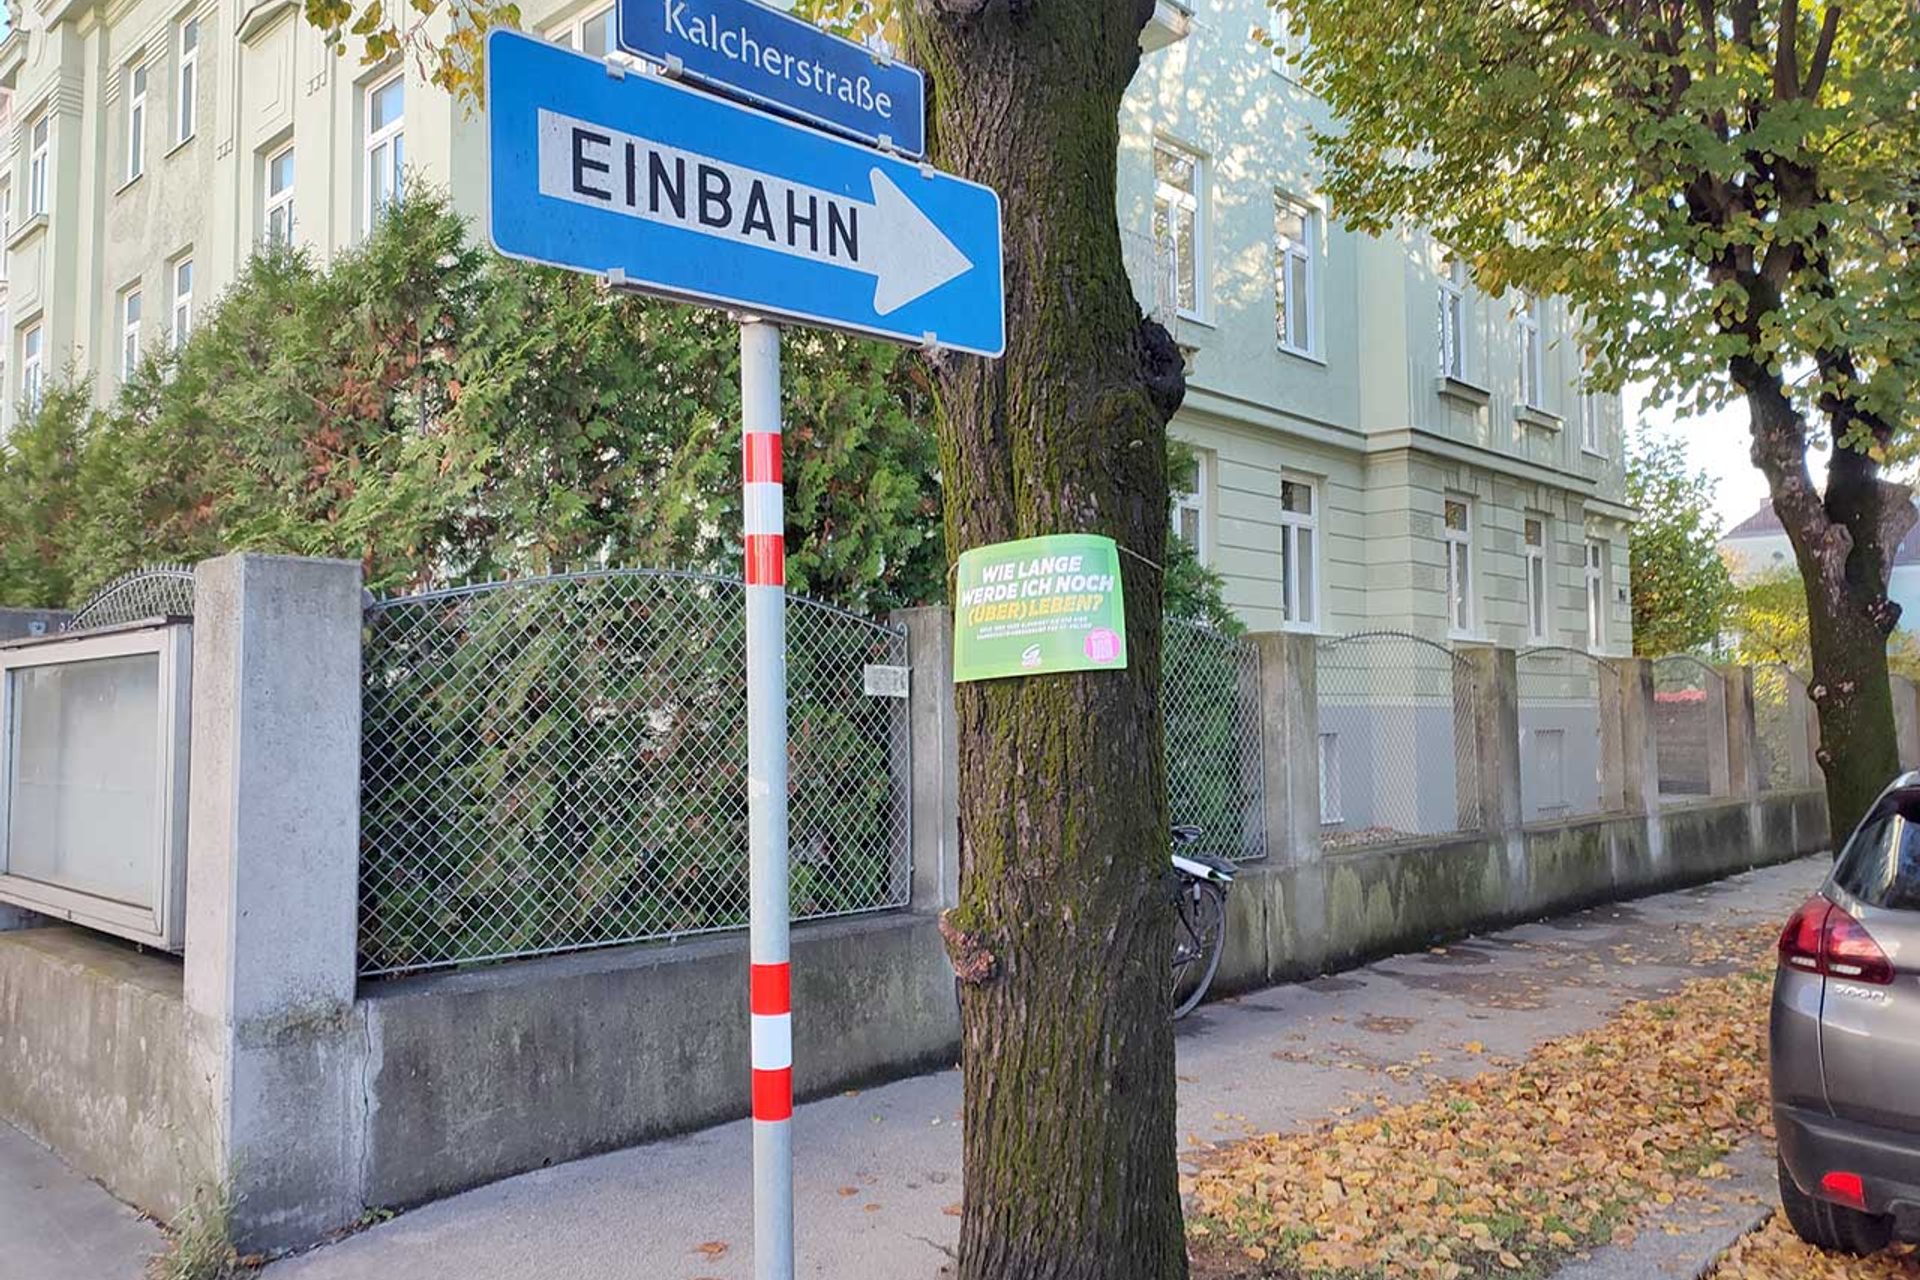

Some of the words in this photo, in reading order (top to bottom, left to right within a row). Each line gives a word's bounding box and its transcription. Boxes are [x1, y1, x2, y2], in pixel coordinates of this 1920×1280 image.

[663, 0, 893, 118] Kalcherstraße
[571, 127, 859, 262] EINBAHN
[961, 583, 1018, 608] WERDE
[1021, 577, 1052, 598] ICH
[1055, 574, 1114, 593] NOCH
[982, 562, 1015, 583] WIE
[1018, 556, 1083, 578] LANGE
